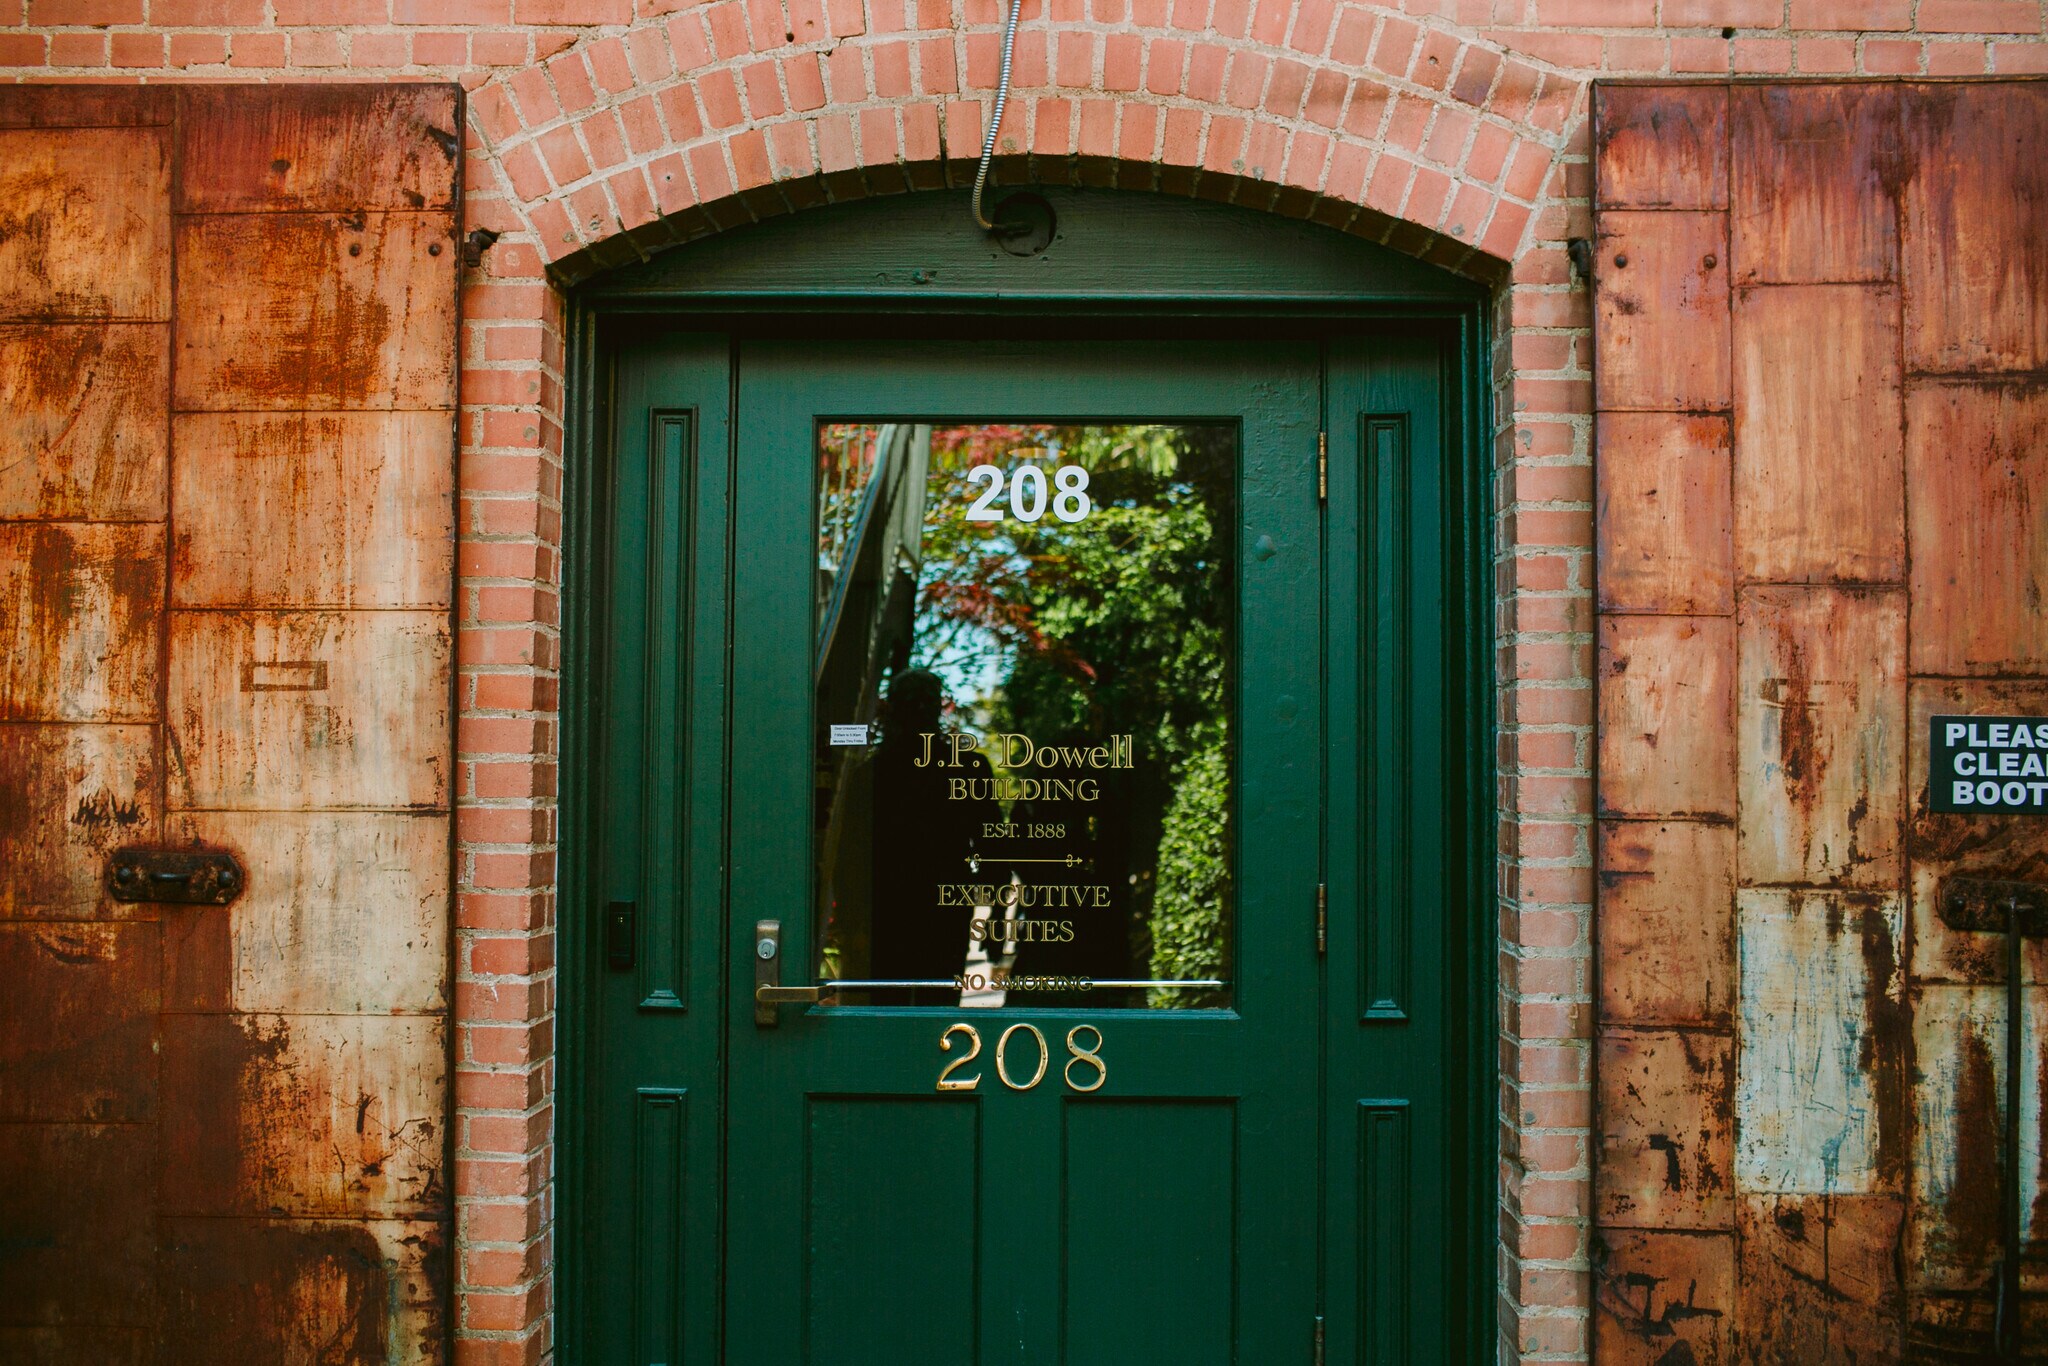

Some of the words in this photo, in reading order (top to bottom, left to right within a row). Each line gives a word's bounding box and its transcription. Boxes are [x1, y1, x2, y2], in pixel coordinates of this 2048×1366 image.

[965, 464, 1091, 523] 208
[914, 733, 980, 768] J.P.
[998, 733, 1135, 769] Dowell
[1953, 752, 2048, 777] CLEA
[948, 778, 1100, 802] BUILDING
[982, 823, 1020, 839] EST.
[1027, 823, 1066, 839] 1888
[937, 884, 1111, 908] EXECUTIVE
[970, 919, 1075, 943] SUITES
[953, 974, 986, 991] NO
[990, 974, 1093, 992] SMOKING
[936, 1022, 1107, 1093] 208
